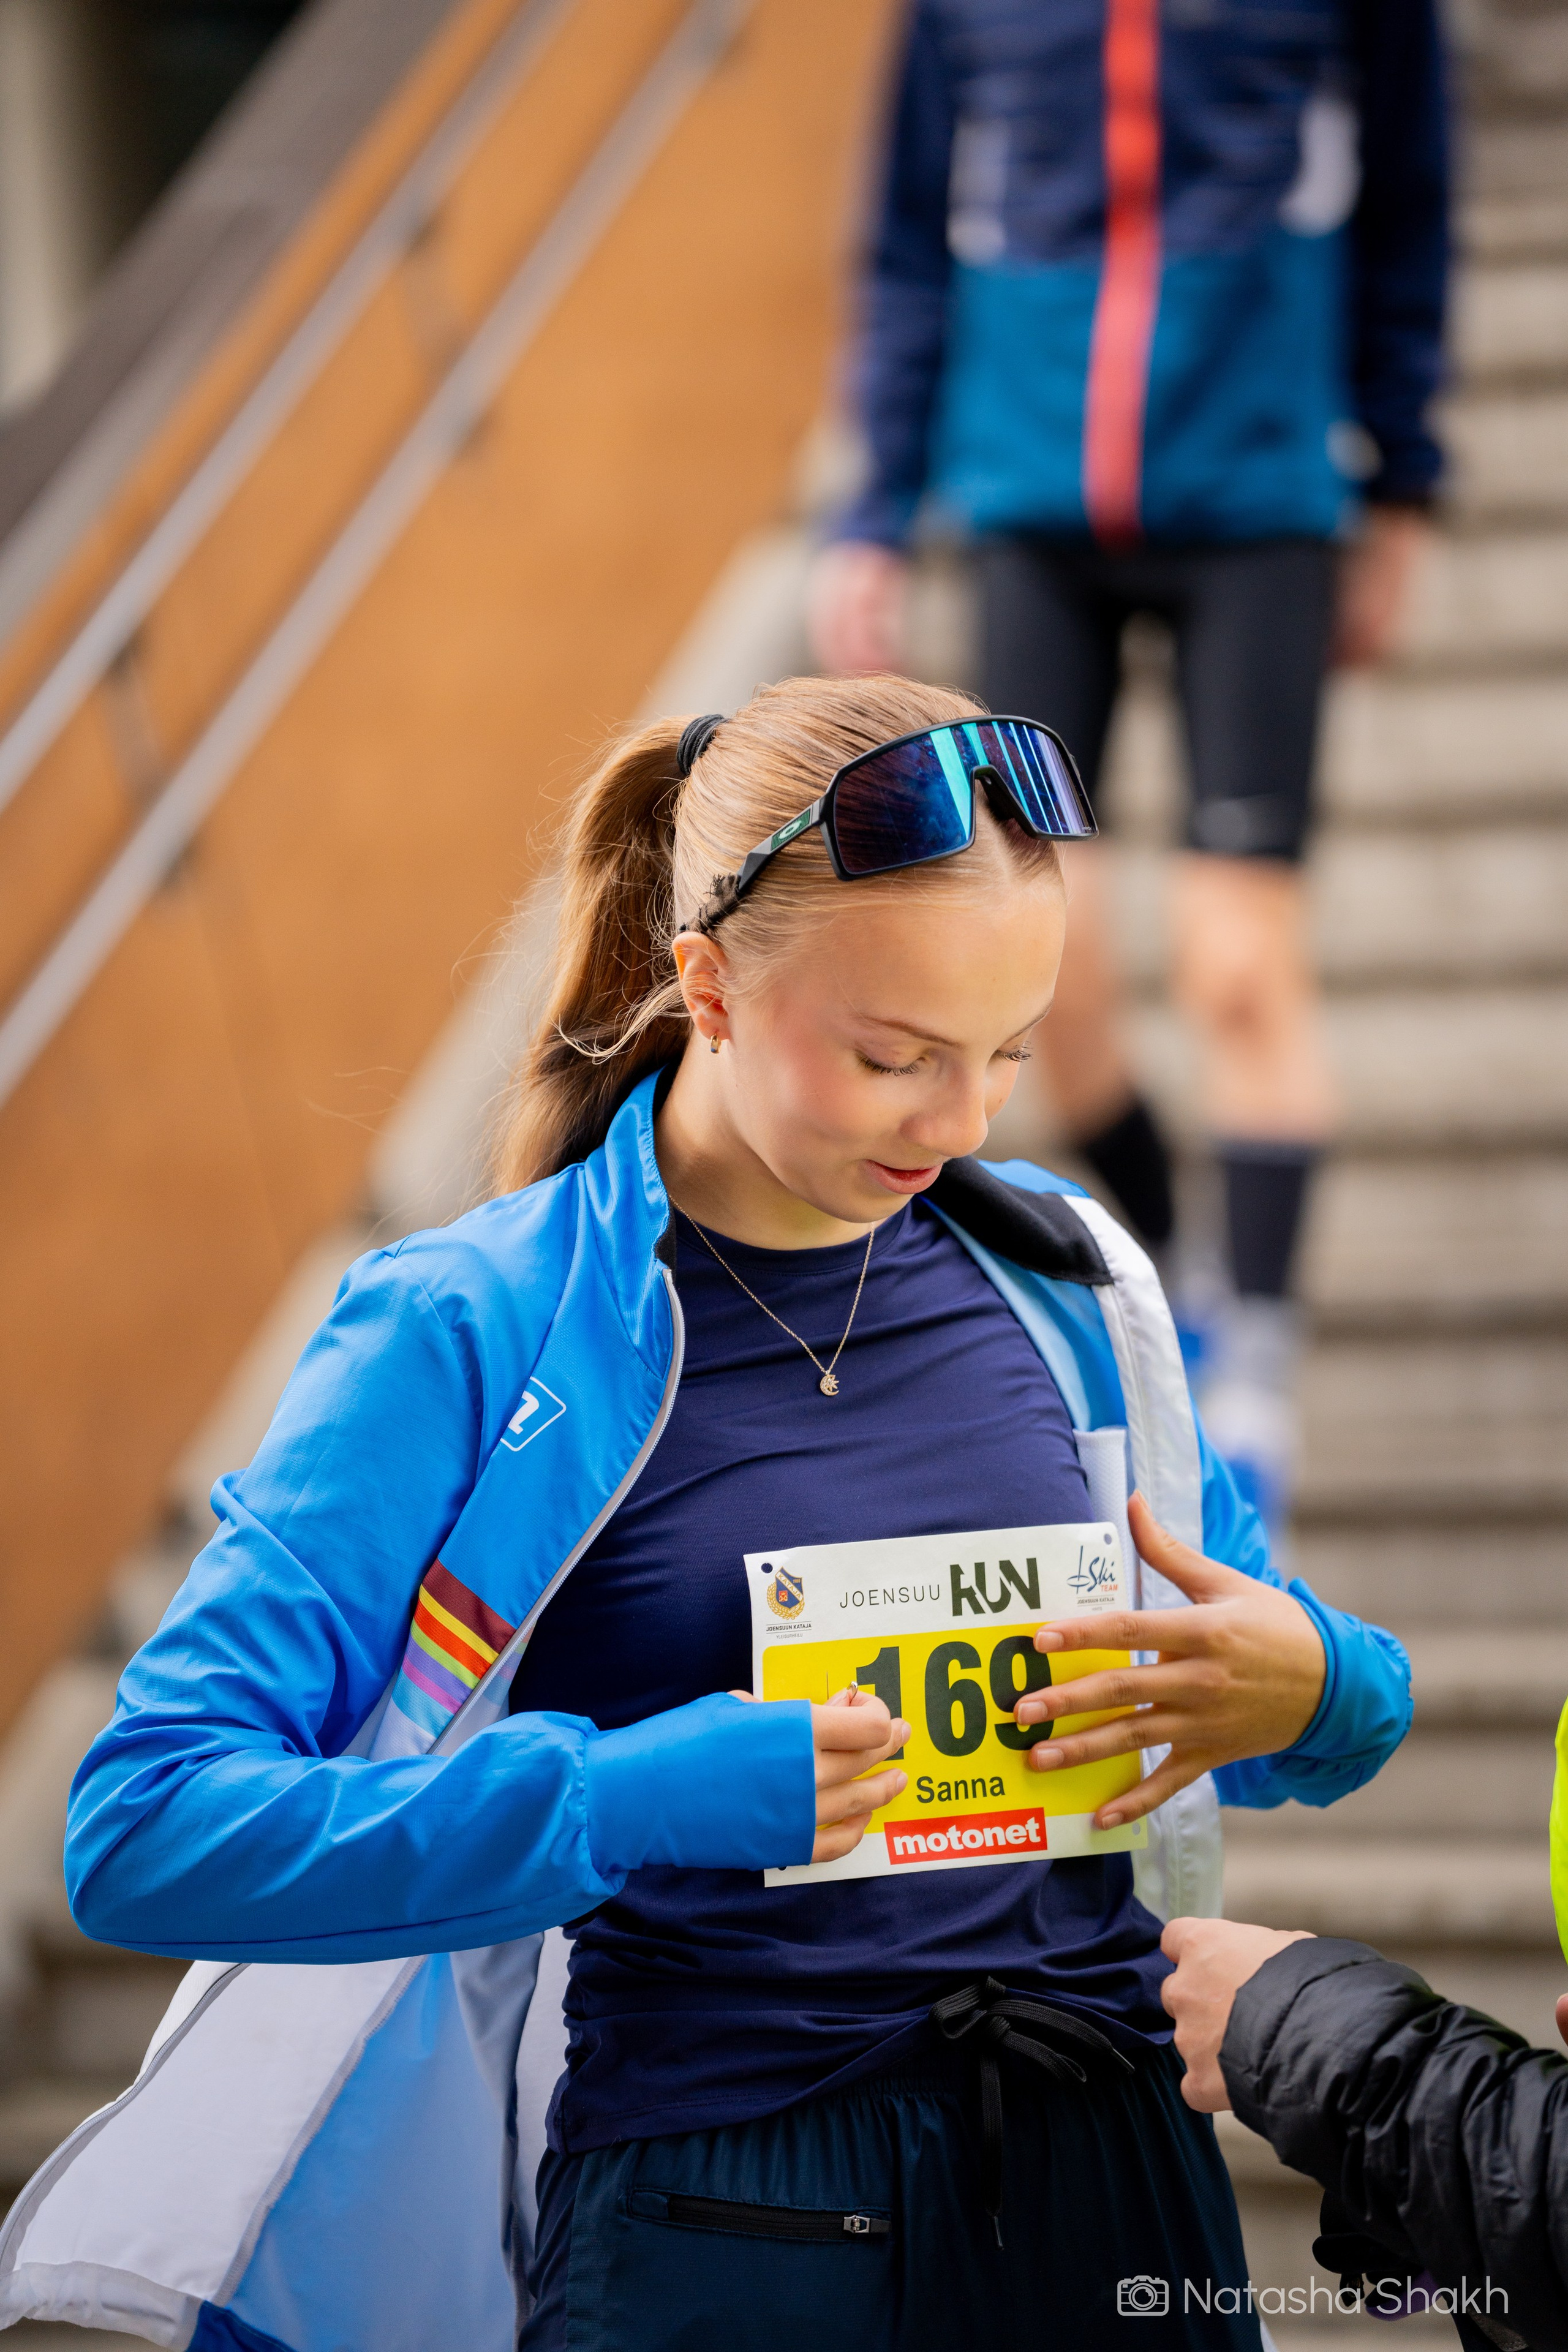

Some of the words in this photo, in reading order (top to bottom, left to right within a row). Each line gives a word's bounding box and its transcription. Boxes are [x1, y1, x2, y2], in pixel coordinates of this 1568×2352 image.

[778, 1573, 801, 1599] KATAJA
[840, 1584, 940, 1608] JOENSUU
[950, 1558, 1041, 1616] RUN
[1087, 1556, 1115, 1593] Ski
[856, 1635, 1055, 1762] 169
[916, 1776, 1006, 1803] Sanna
[893, 1817, 1041, 1856] motonet
